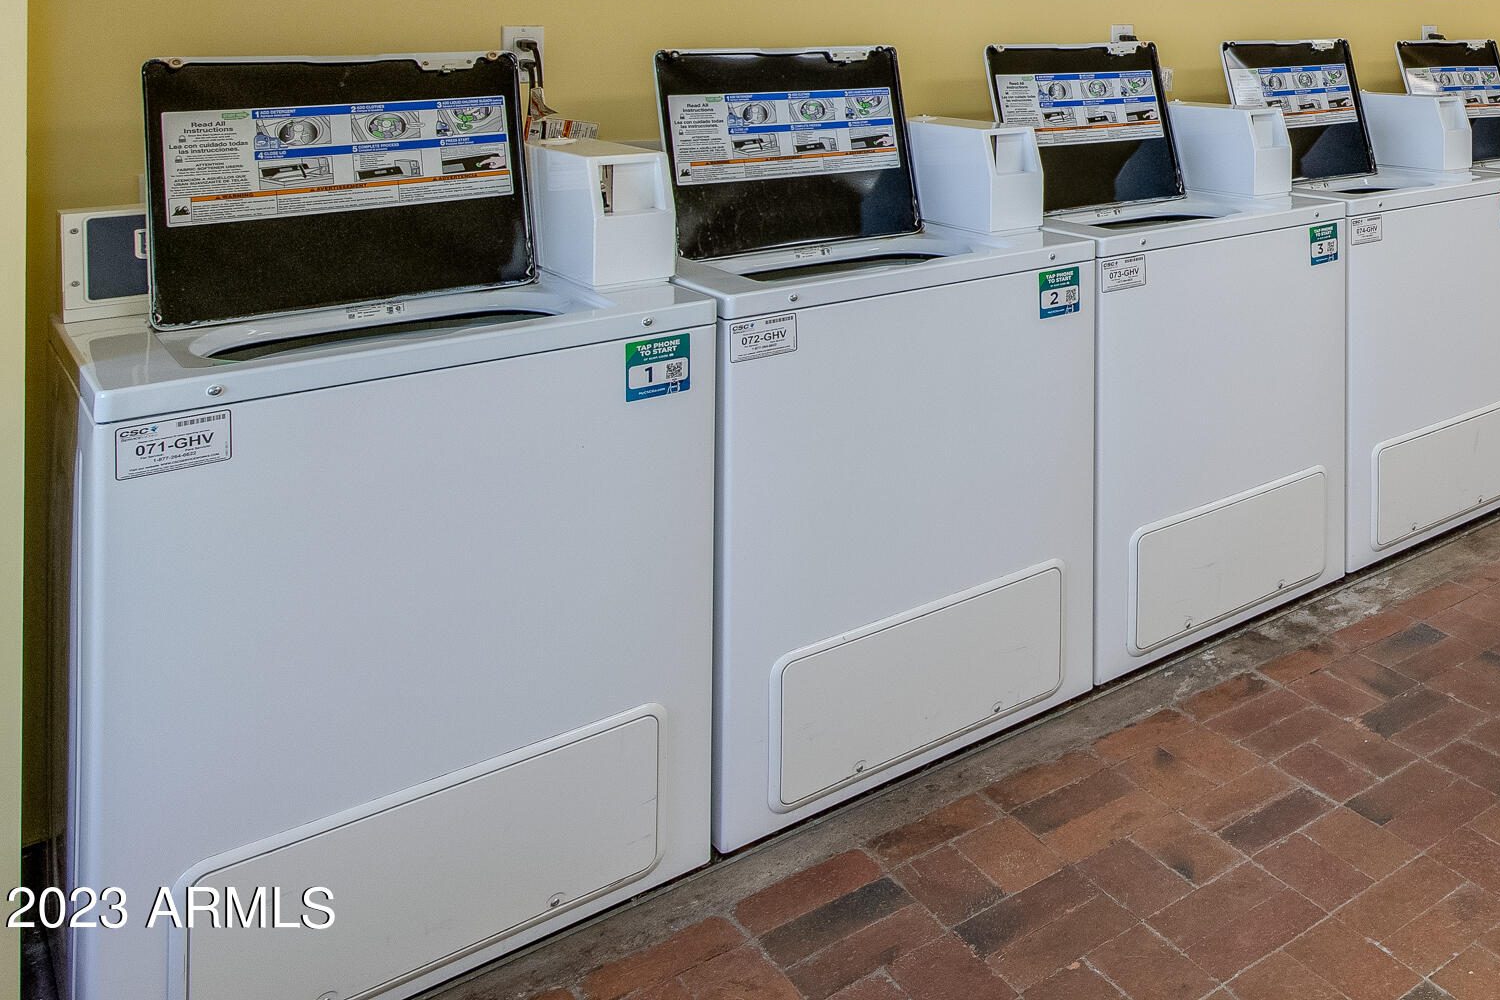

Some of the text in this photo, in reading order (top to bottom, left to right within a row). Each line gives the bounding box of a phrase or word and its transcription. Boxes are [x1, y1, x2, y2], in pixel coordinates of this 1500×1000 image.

[1318, 243, 1323, 254] 3
[1109, 268, 1139, 279] 073-GHV
[1050, 292, 1058, 305] 2
[742, 329, 786, 345] 072-GHV
[653, 339, 680, 348] PHONE
[652, 346, 677, 354] START
[645, 366, 652, 383] 1
[120, 427, 149, 437] CSC
[136, 432, 214, 456] 071-GHV
